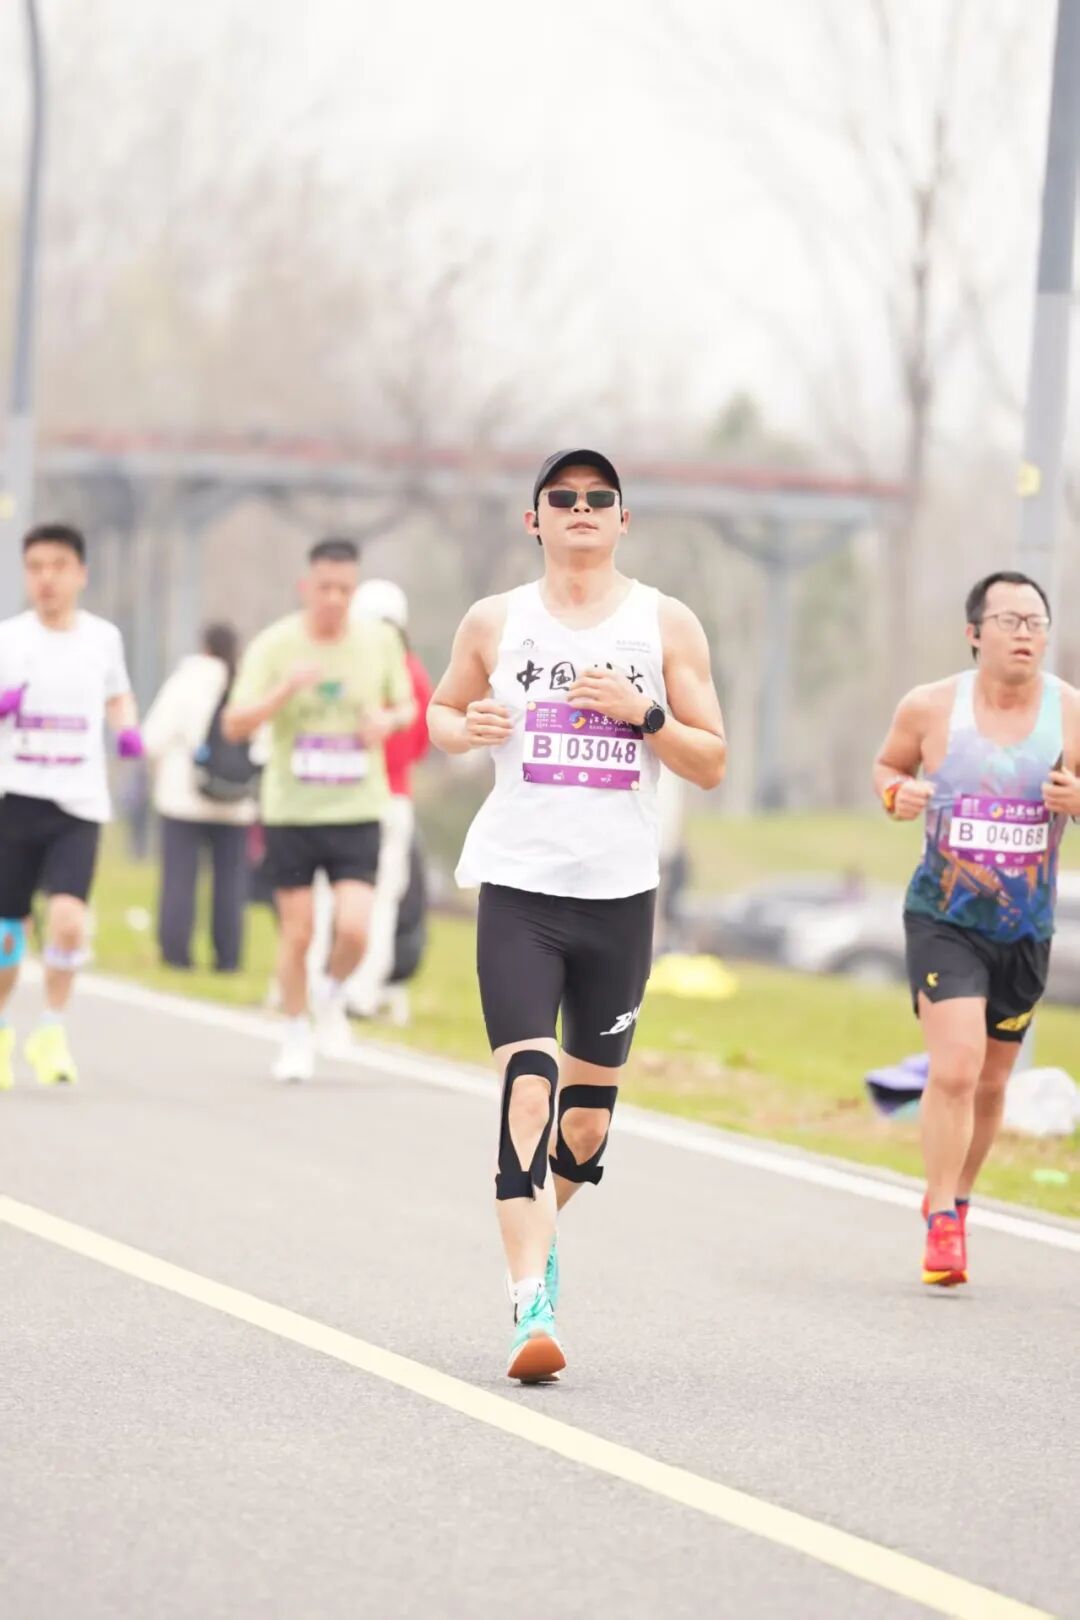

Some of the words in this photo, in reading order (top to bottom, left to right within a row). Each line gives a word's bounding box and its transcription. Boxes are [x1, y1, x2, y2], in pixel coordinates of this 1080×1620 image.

[516, 659, 644, 693] 中国大
[532, 734, 552, 759] B
[566, 737, 637, 764] 03048
[959, 822, 973, 842] B
[986, 825, 1044, 847] 04068
